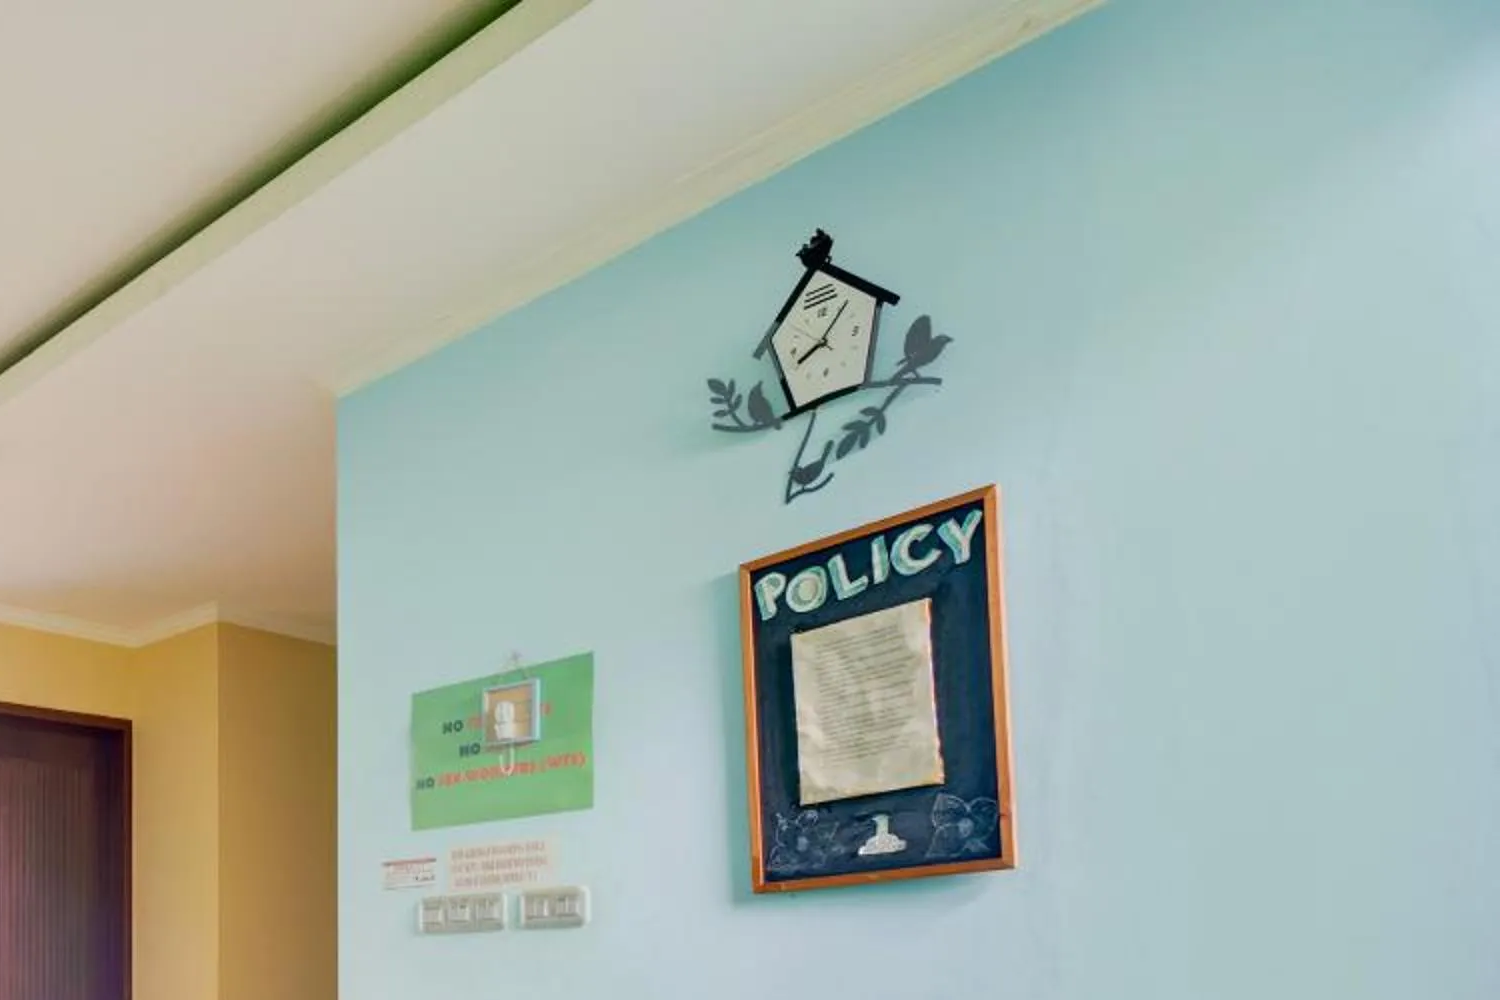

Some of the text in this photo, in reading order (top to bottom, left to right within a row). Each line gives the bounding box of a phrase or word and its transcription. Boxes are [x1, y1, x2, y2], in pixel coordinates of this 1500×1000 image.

[754, 509, 983, 621] POLICY
[442, 719, 464, 735] NO
[459, 742, 481, 757] NO
[416, 776, 435, 790] NO
